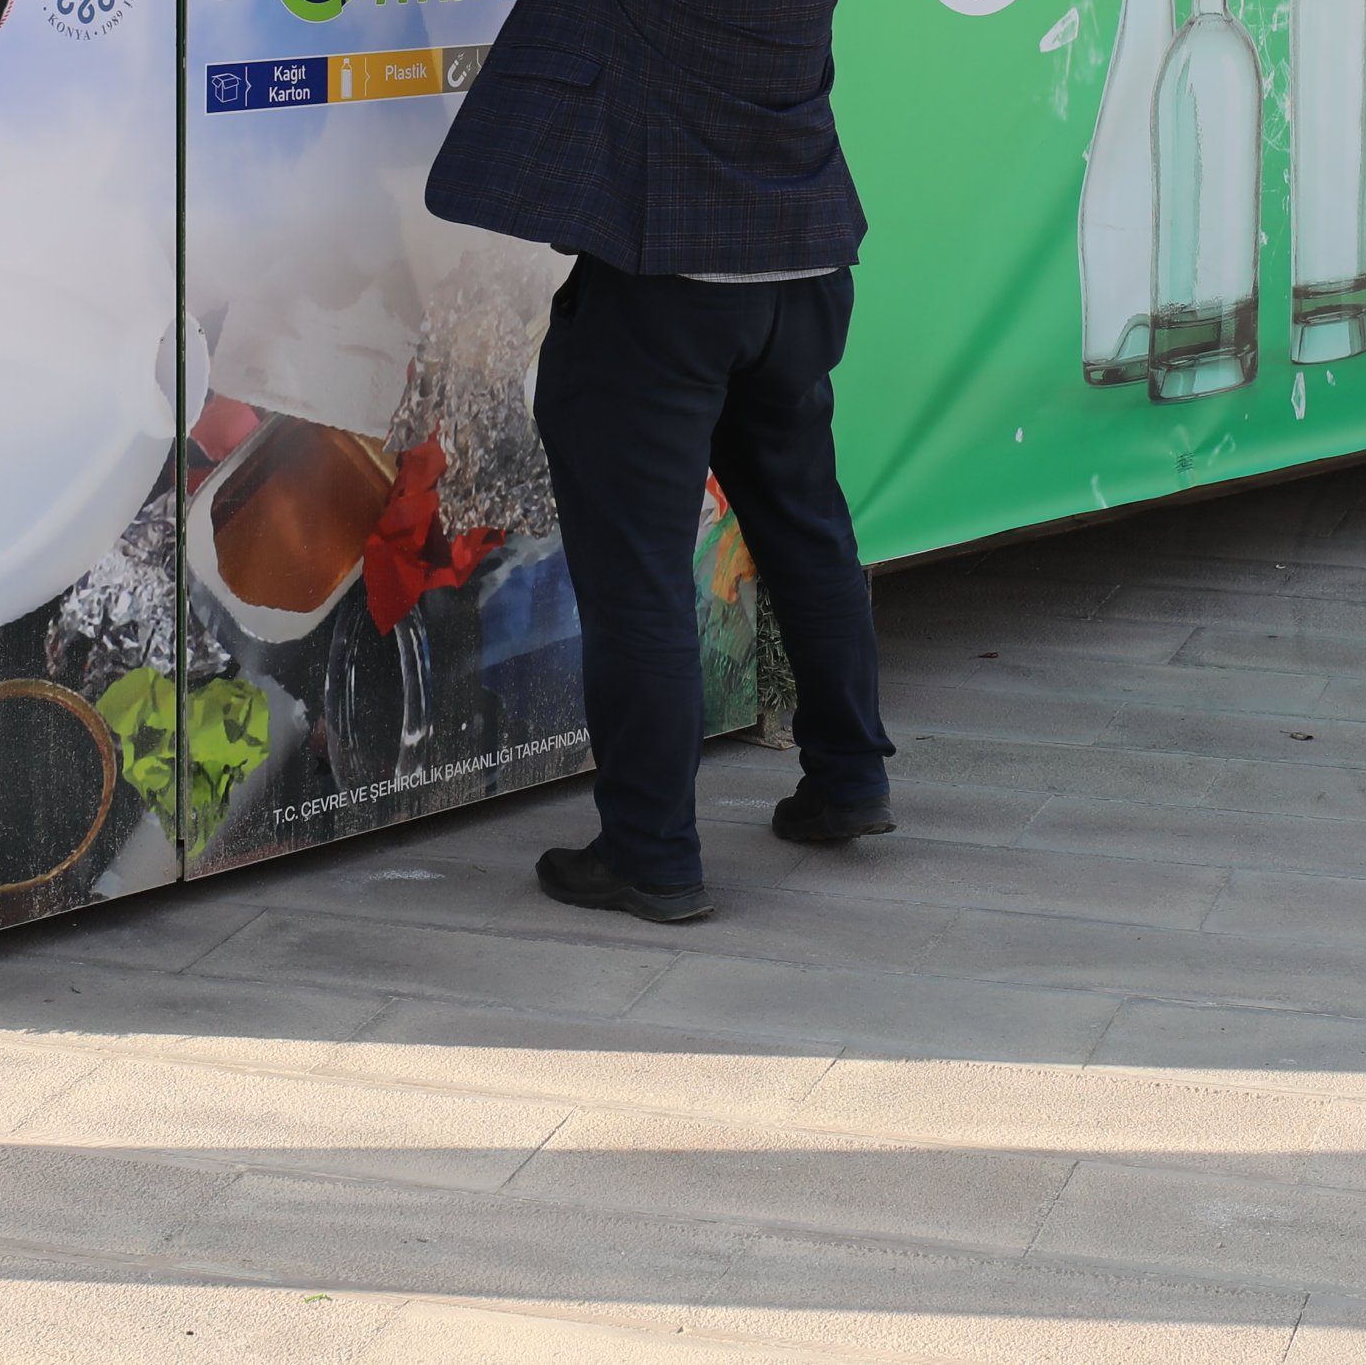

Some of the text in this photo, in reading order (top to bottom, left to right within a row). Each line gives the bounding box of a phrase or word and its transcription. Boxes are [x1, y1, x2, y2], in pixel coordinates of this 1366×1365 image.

[47, 10, 124, 41] KONYA 1989
[273, 64, 306, 85] Kağıt
[384, 63, 428, 82] Plastik
[268, 85, 311, 103] Karton
[272, 806, 299, 825] T.C.
[300, 790, 348, 822] ÇEVRE
[350, 785, 369, 806] VE
[444, 746, 512, 778] BAKANLIĞI
